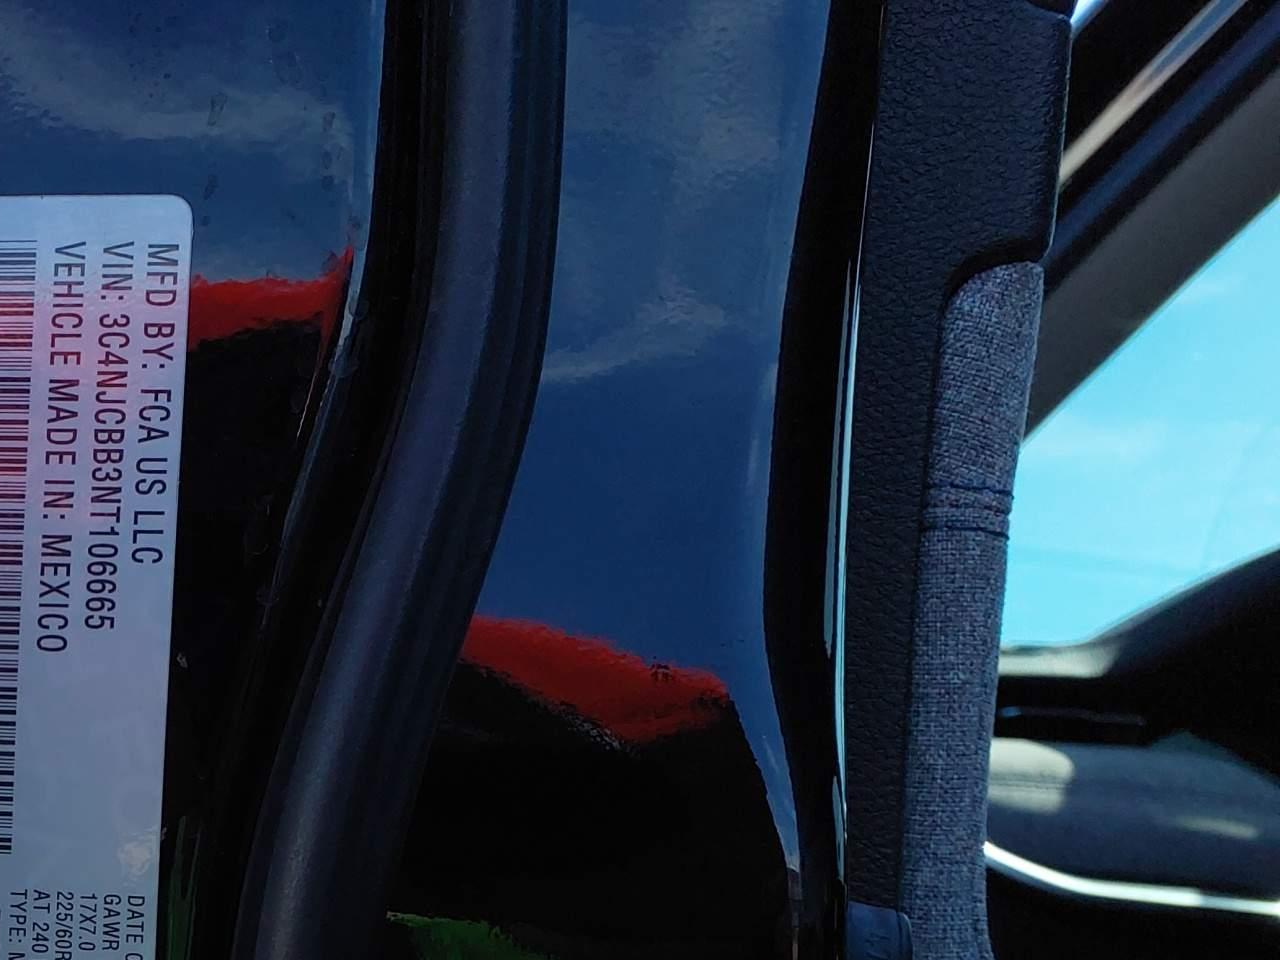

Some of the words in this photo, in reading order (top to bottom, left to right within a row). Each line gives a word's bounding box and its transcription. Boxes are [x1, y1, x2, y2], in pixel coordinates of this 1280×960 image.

[101, 241, 134, 300] VIN:
[146, 244, 179, 306] MFD
[50, 242, 86, 365] VEHICLE
[142, 323, 175, 368] BY:
[46, 379, 80, 465] MADE
[138, 389, 172, 443] FCA
[84, 314, 130, 629] 3C4NJCBB3NT106665
[135, 458, 168, 495] US
[43, 480, 75, 519] IN:
[132, 510, 165, 564] LLC
[36, 534, 72, 652] MEXICO
[9, 889, 28, 943] TYPE:
[33, 890, 51, 914] AT
[78, 893, 98, 951] 17X7.0
[102, 894, 122, 950] GAWR
[126, 896, 145, 944] DATE
[32, 922, 50, 953] 240
